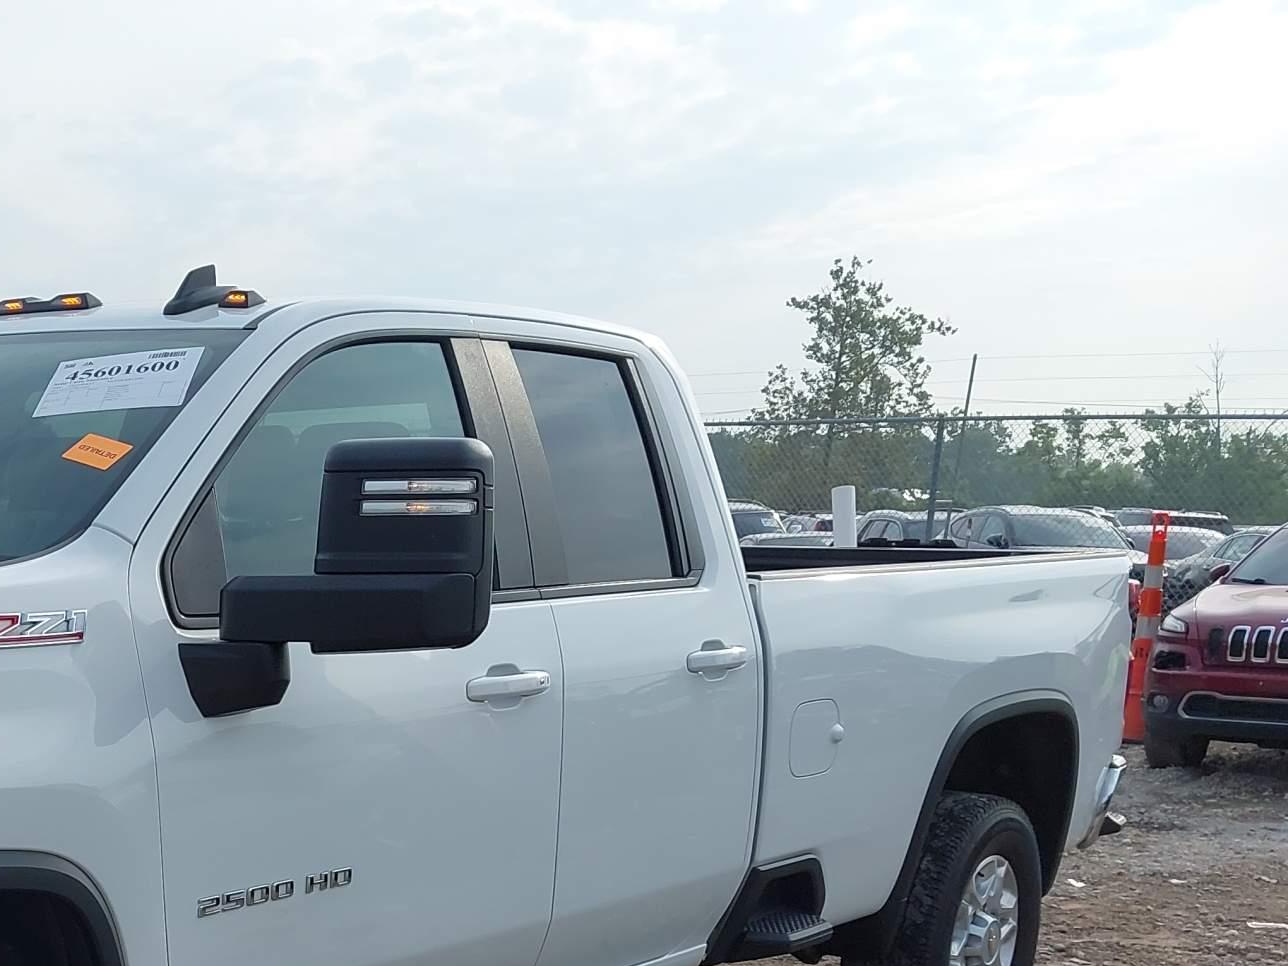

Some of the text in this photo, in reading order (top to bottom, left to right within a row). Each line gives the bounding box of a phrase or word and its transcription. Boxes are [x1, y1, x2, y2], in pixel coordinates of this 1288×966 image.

[65, 360, 180, 380] 45601600
[78, 444, 117, 460] DETAILED
[197, 866, 353, 918] 2500 HD
